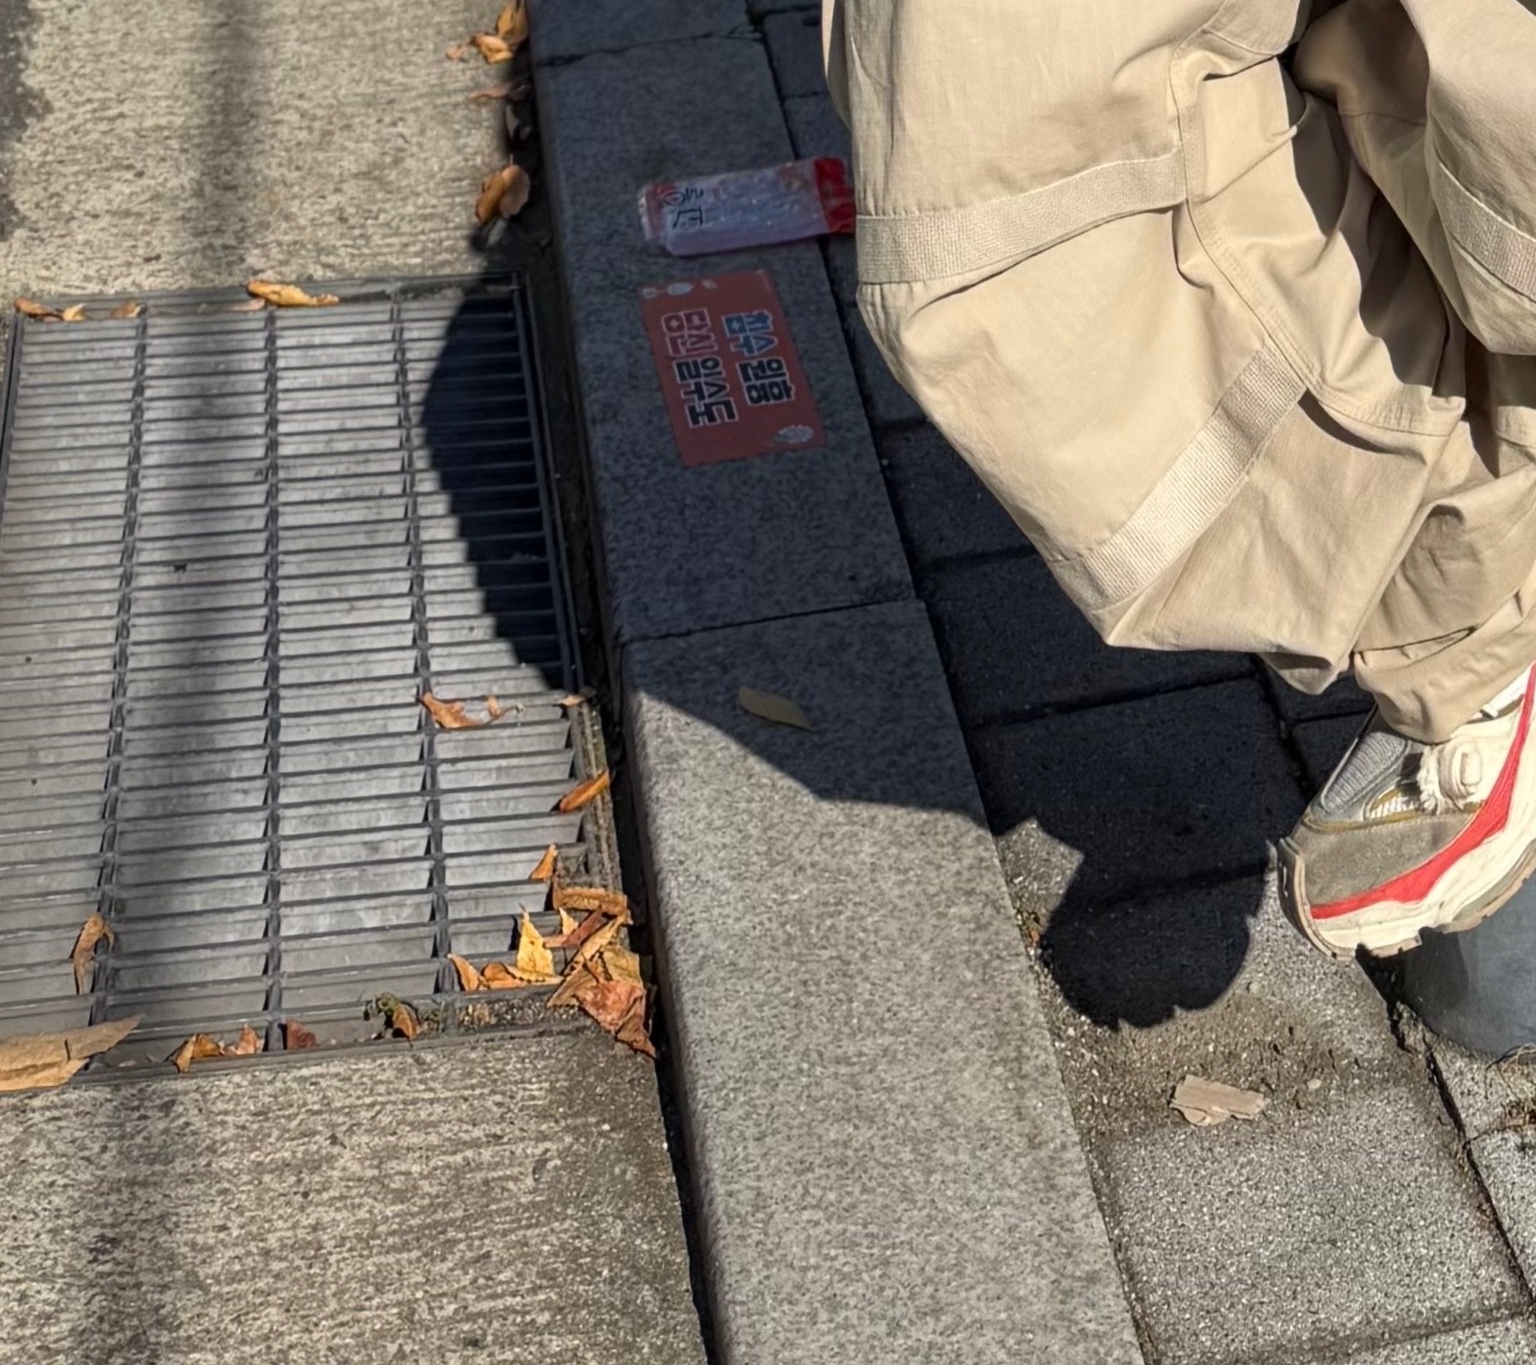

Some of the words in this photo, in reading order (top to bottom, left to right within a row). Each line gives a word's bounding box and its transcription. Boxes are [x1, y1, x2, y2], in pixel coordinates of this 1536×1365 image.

[660, 307, 718, 360] 당신
[721, 309, 779, 357] 침수
[672, 355, 740, 429] 일수도
[738, 355, 796, 407] 원흉
